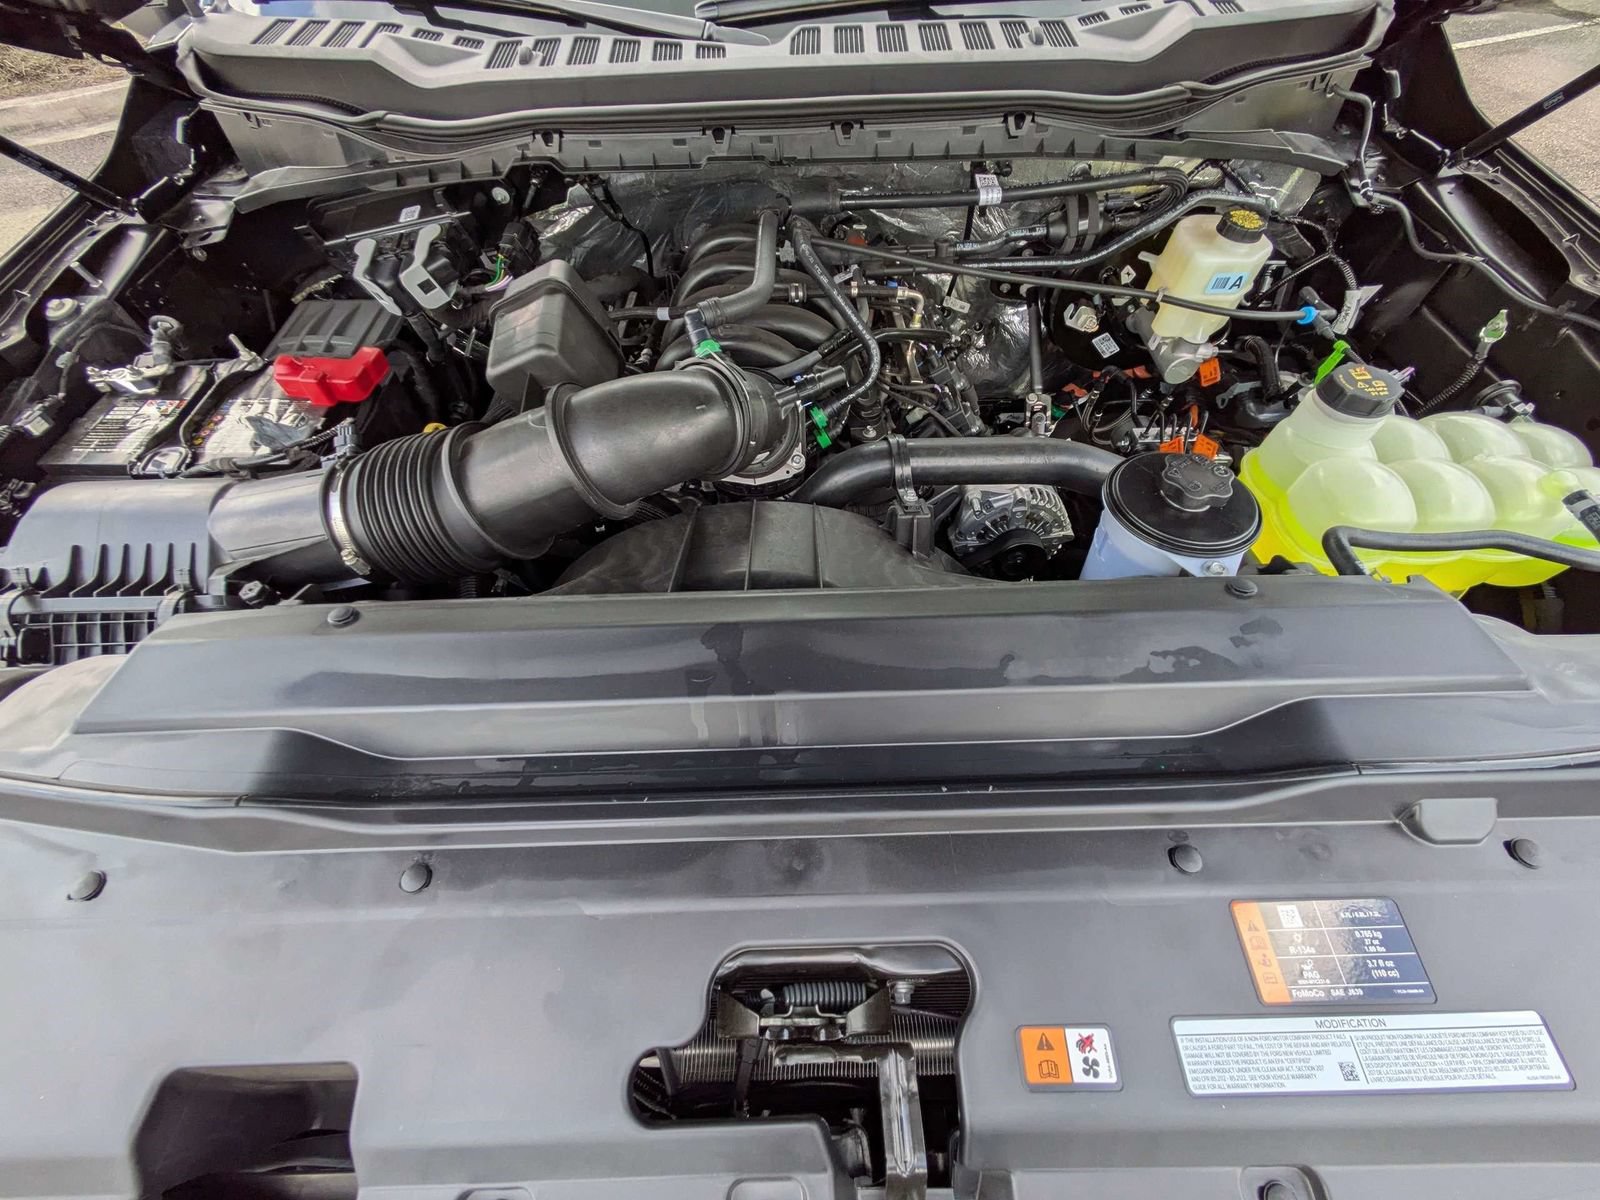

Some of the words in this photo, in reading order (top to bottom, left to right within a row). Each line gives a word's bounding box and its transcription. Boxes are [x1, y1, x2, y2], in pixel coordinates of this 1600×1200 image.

[1228, 276, 1243, 290] A
[1372, 930, 1382, 939] kg
[1366, 959, 1378, 968] 3.7
[1302, 971, 1320, 979] PAG
[1388, 968, 1400, 978] cc)
[1292, 988, 1325, 998] FoMoCo
[1330, 988, 1346, 996] SAE
[1314, 1018, 1386, 1028] MODIFICATION
